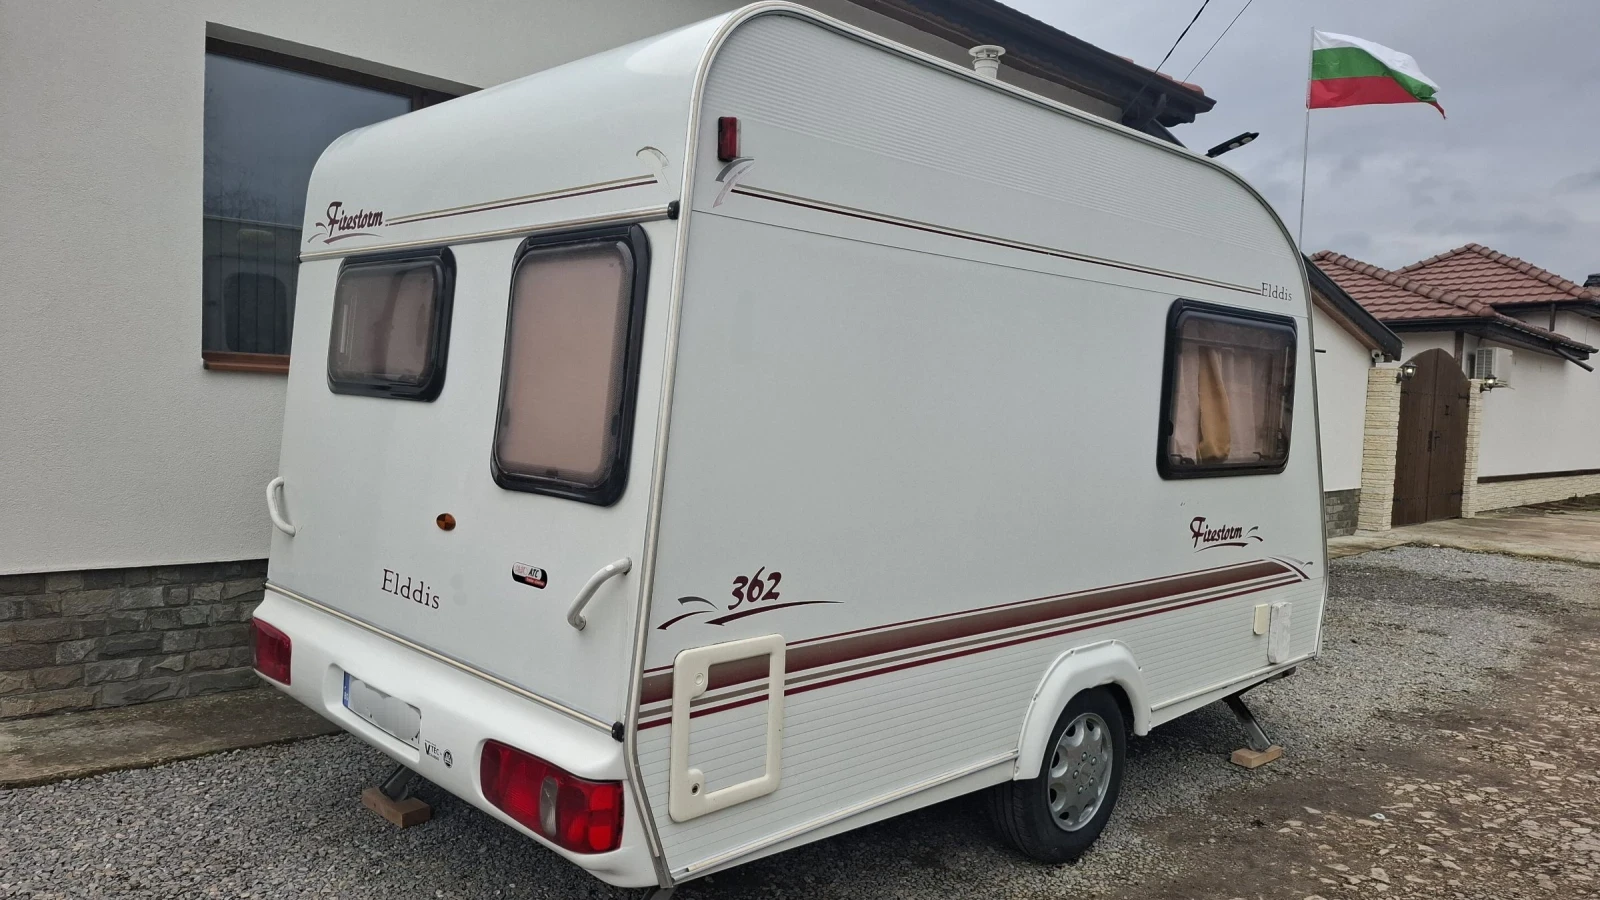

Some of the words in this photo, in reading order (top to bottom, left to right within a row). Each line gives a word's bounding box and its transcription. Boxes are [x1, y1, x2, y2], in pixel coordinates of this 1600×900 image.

[326, 201, 383, 238] Firestorm
[1261, 282, 1293, 301] Elddis
[1189, 516, 1243, 549] Firestorm
[381, 568, 440, 610] Elddis
[727, 566, 782, 611] 362
